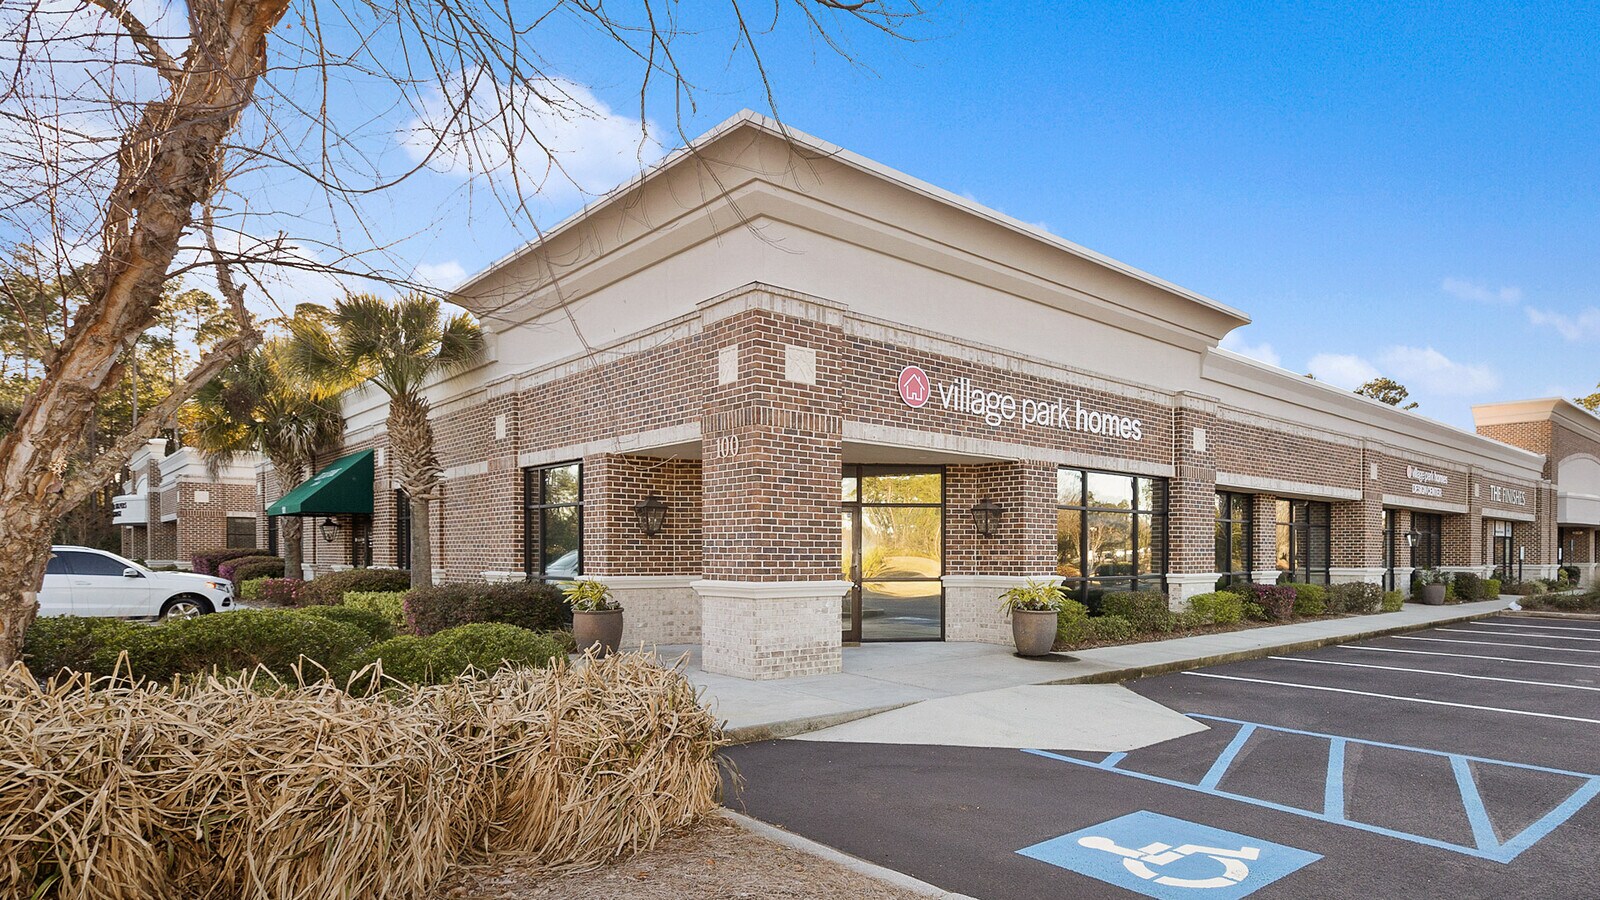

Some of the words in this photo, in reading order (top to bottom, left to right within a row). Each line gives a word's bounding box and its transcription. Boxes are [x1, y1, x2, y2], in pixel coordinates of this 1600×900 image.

[938, 377, 1016, 427] village
[1022, 397, 1070, 429] park
[1076, 399, 1142, 441] homes
[716, 435, 739, 458] 100
[1490, 484, 1502, 502] THE
[1503, 487, 1526, 506] FINISHES
